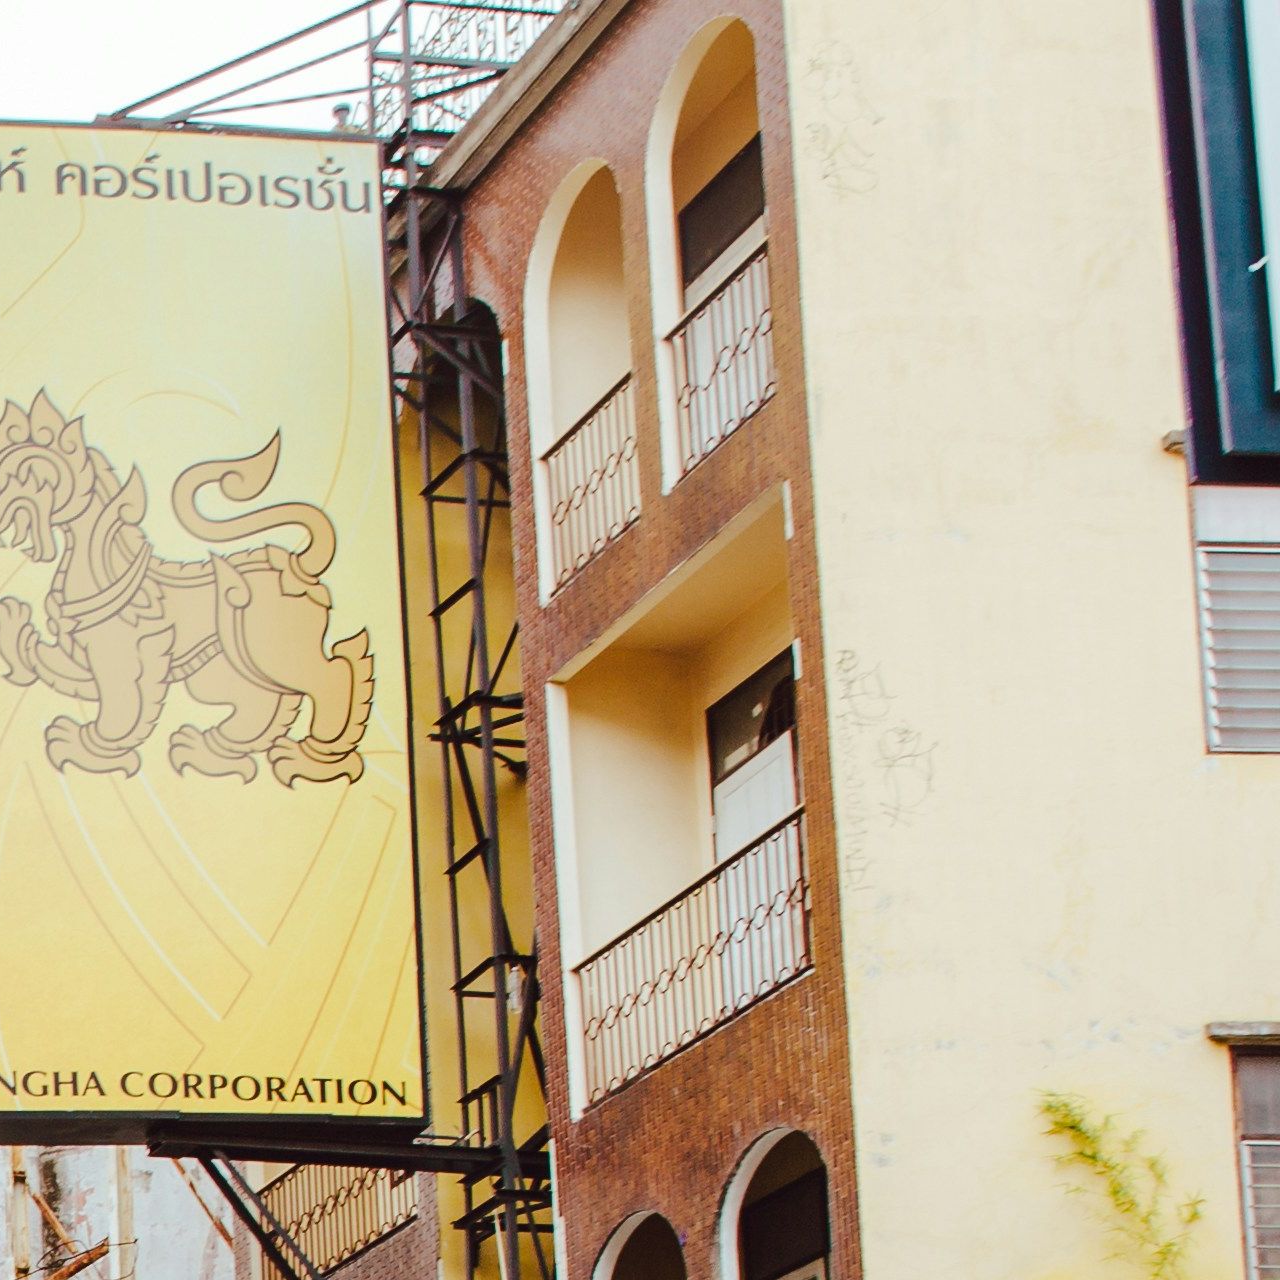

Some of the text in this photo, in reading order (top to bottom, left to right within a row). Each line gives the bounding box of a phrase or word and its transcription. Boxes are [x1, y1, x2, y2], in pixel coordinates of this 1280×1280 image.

[55, 151, 374, 216] คอร์เปอเรชั่น
[120, 1070, 410, 1107] CORPORATION
